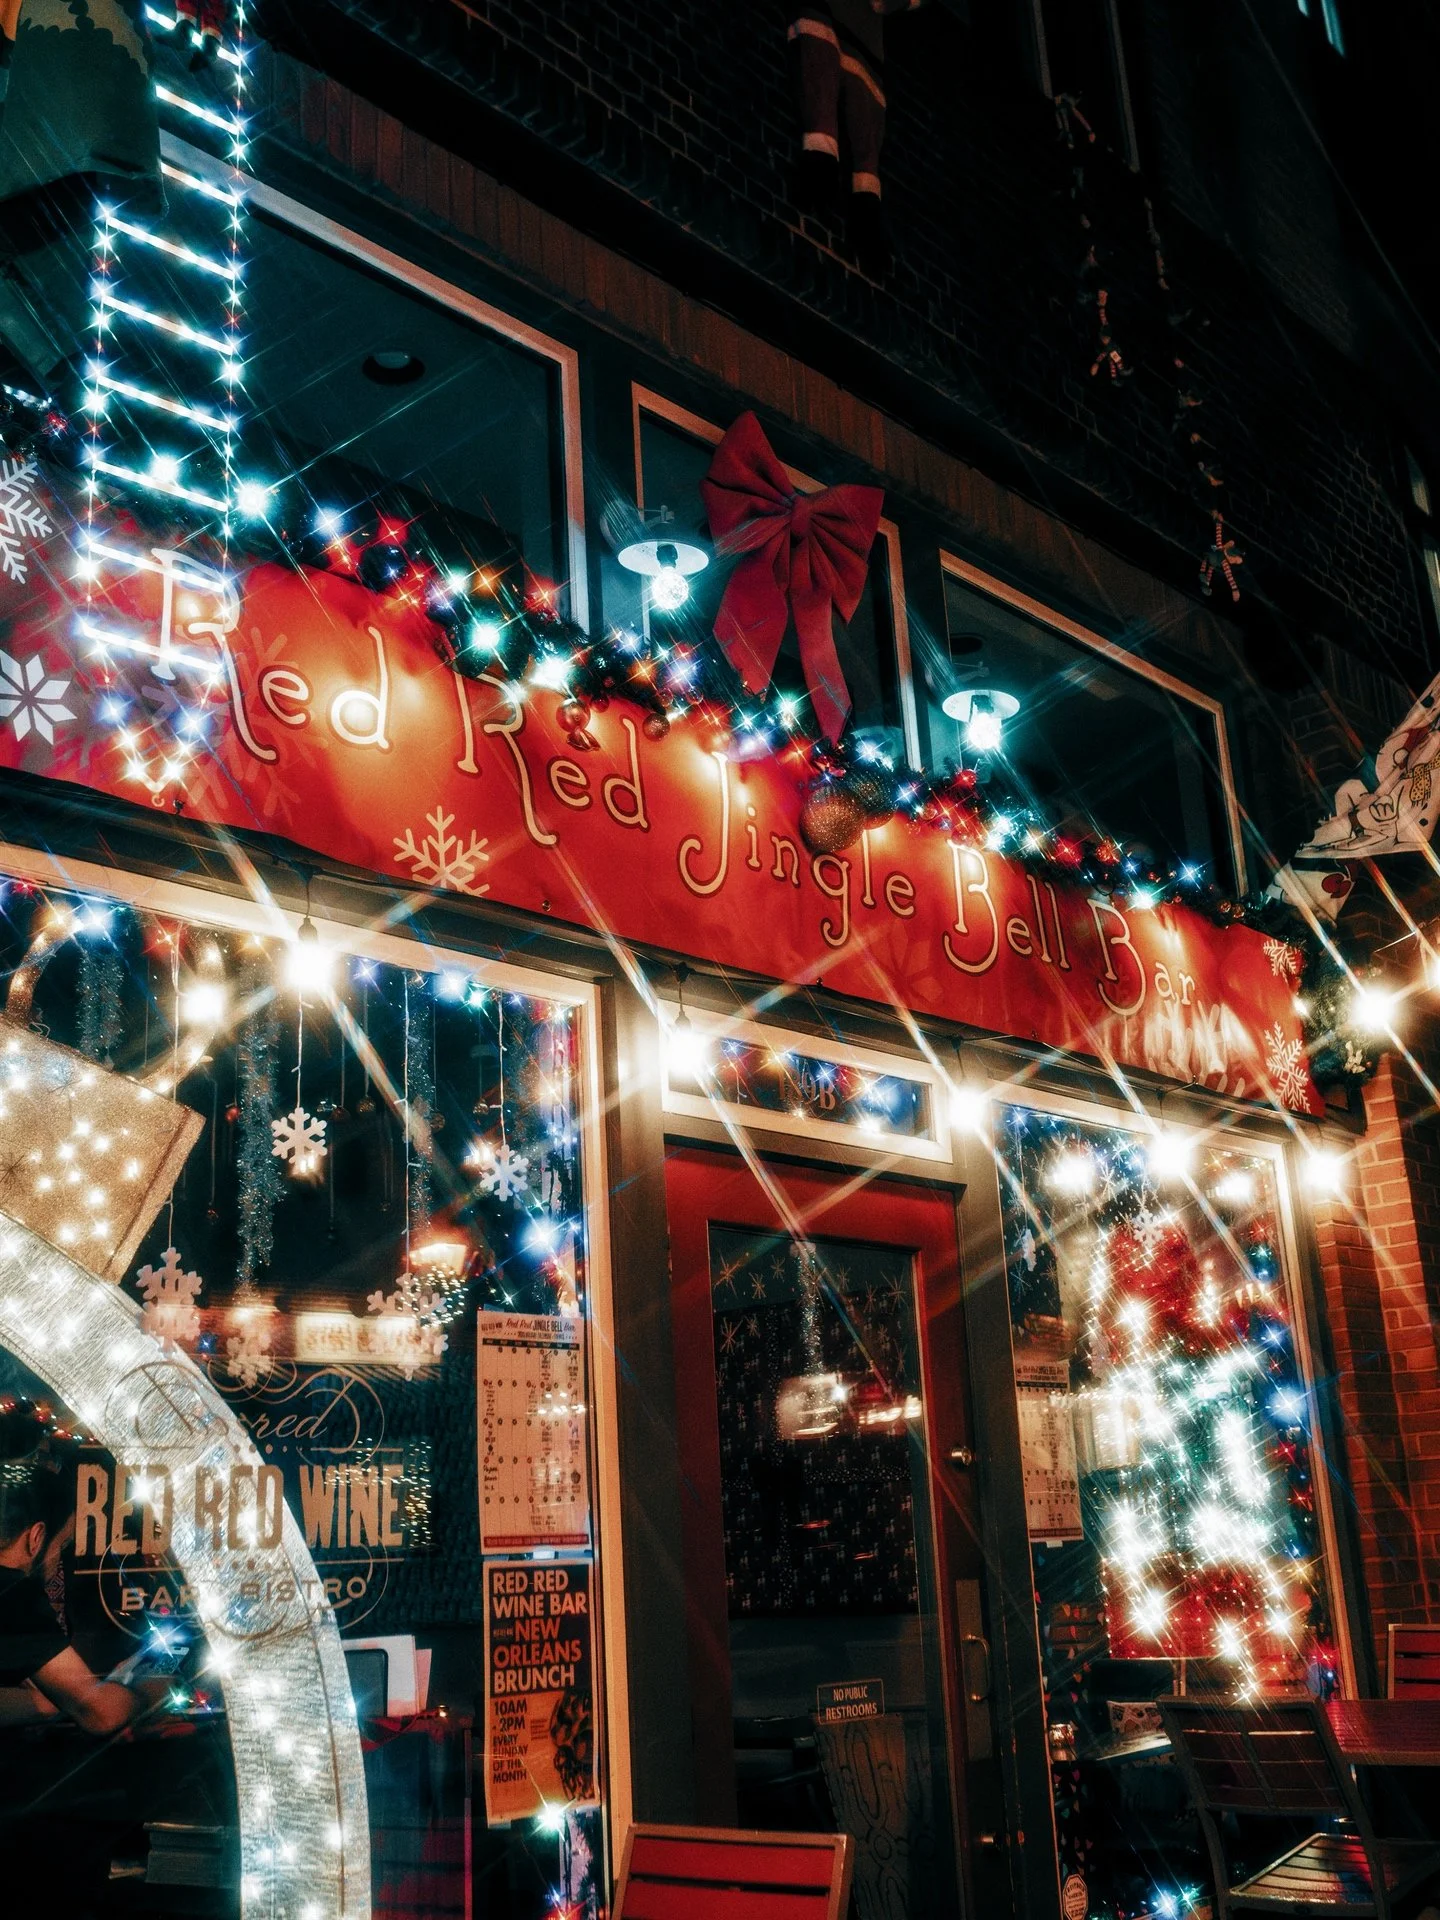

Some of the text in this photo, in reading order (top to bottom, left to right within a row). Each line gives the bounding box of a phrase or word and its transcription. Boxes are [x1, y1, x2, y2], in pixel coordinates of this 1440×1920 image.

[151, 547, 1196, 1016] Red Red Jingle Bell Bar
[74, 1462, 404, 1557] RED RED WINE
[240, 1575, 368, 1604] BISTRO
[493, 1569, 569, 1594] RED RED
[492, 1592, 588, 1619] WINE BAR
[515, 1617, 560, 1642] NEW
[493, 1639, 582, 1669] ORLEANS
[493, 1664, 575, 1694] BRUNCH
[833, 1685, 868, 1702] NO PUBLIC
[494, 1697, 528, 1716] 10AM
[826, 1703, 877, 1720] RESTROOMS
[493, 1744, 528, 1758] SUNDAY
[493, 1759, 503, 1772] OF
[493, 1768, 527, 1784] MONTH
